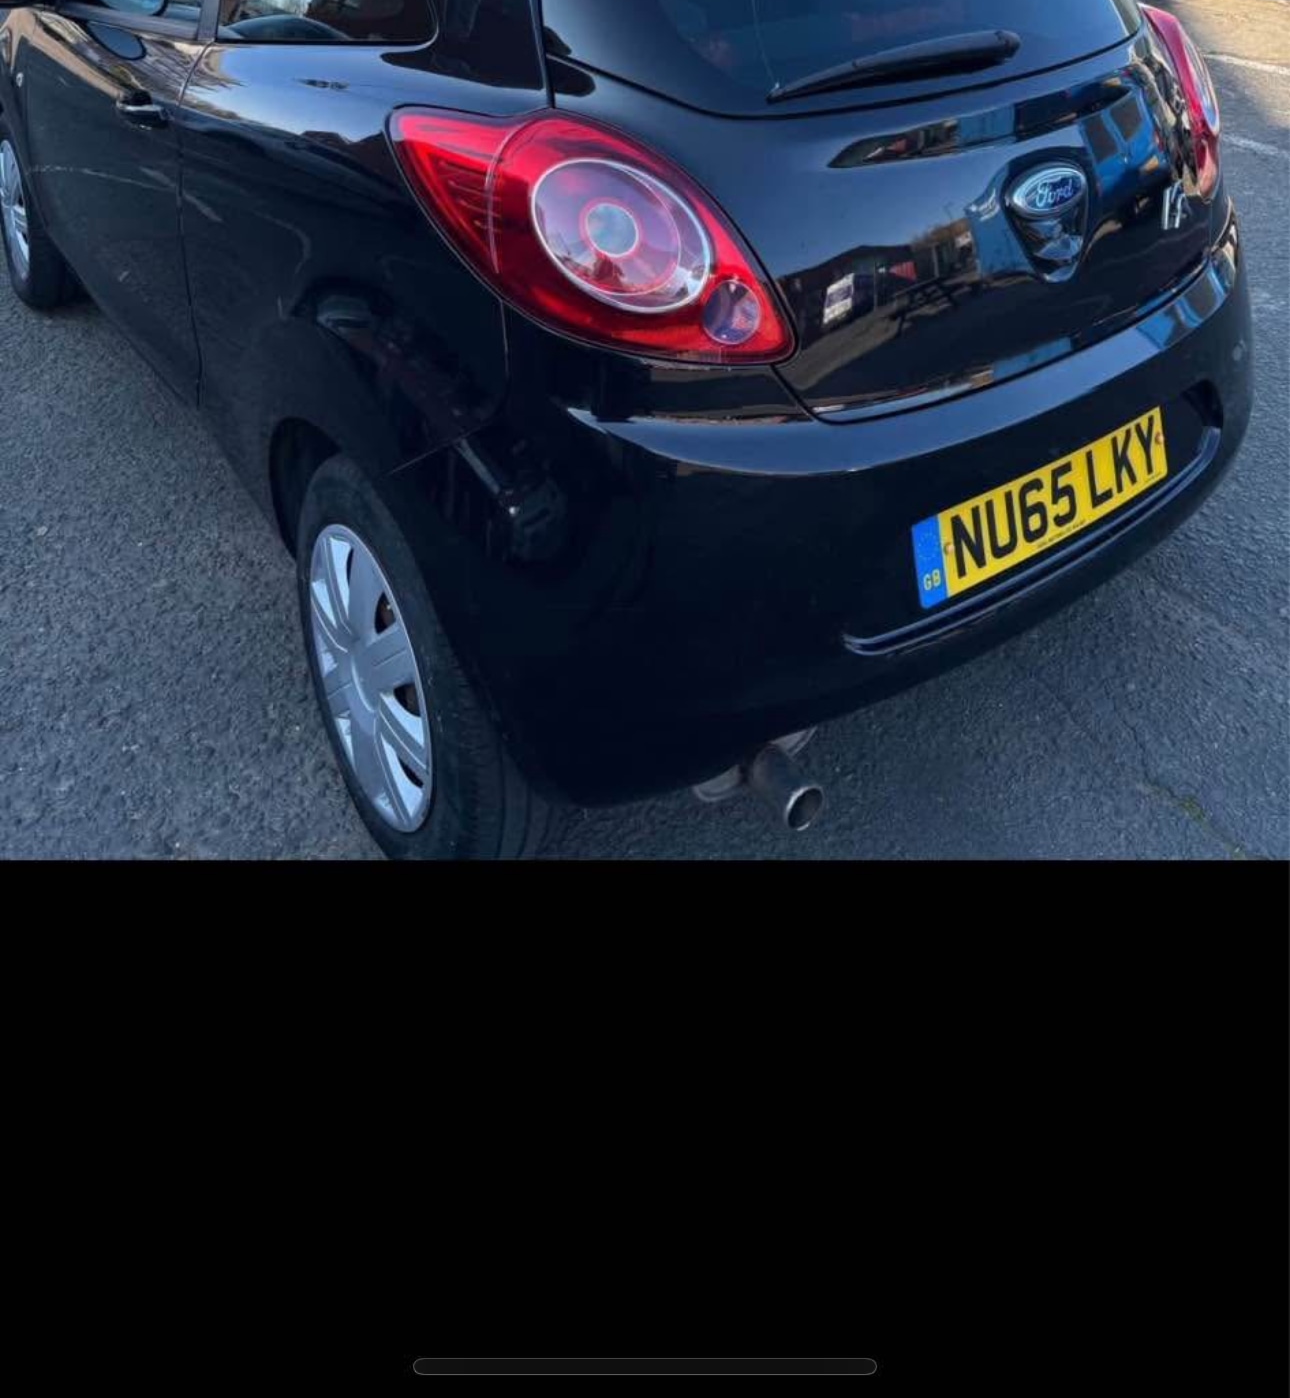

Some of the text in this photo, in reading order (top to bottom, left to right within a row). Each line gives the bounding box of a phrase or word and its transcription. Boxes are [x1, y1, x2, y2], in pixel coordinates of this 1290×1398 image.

[1031, 177, 1073, 208] Ford
[951, 415, 1155, 579] NU65 LKY
[923, 568, 941, 591] GB
